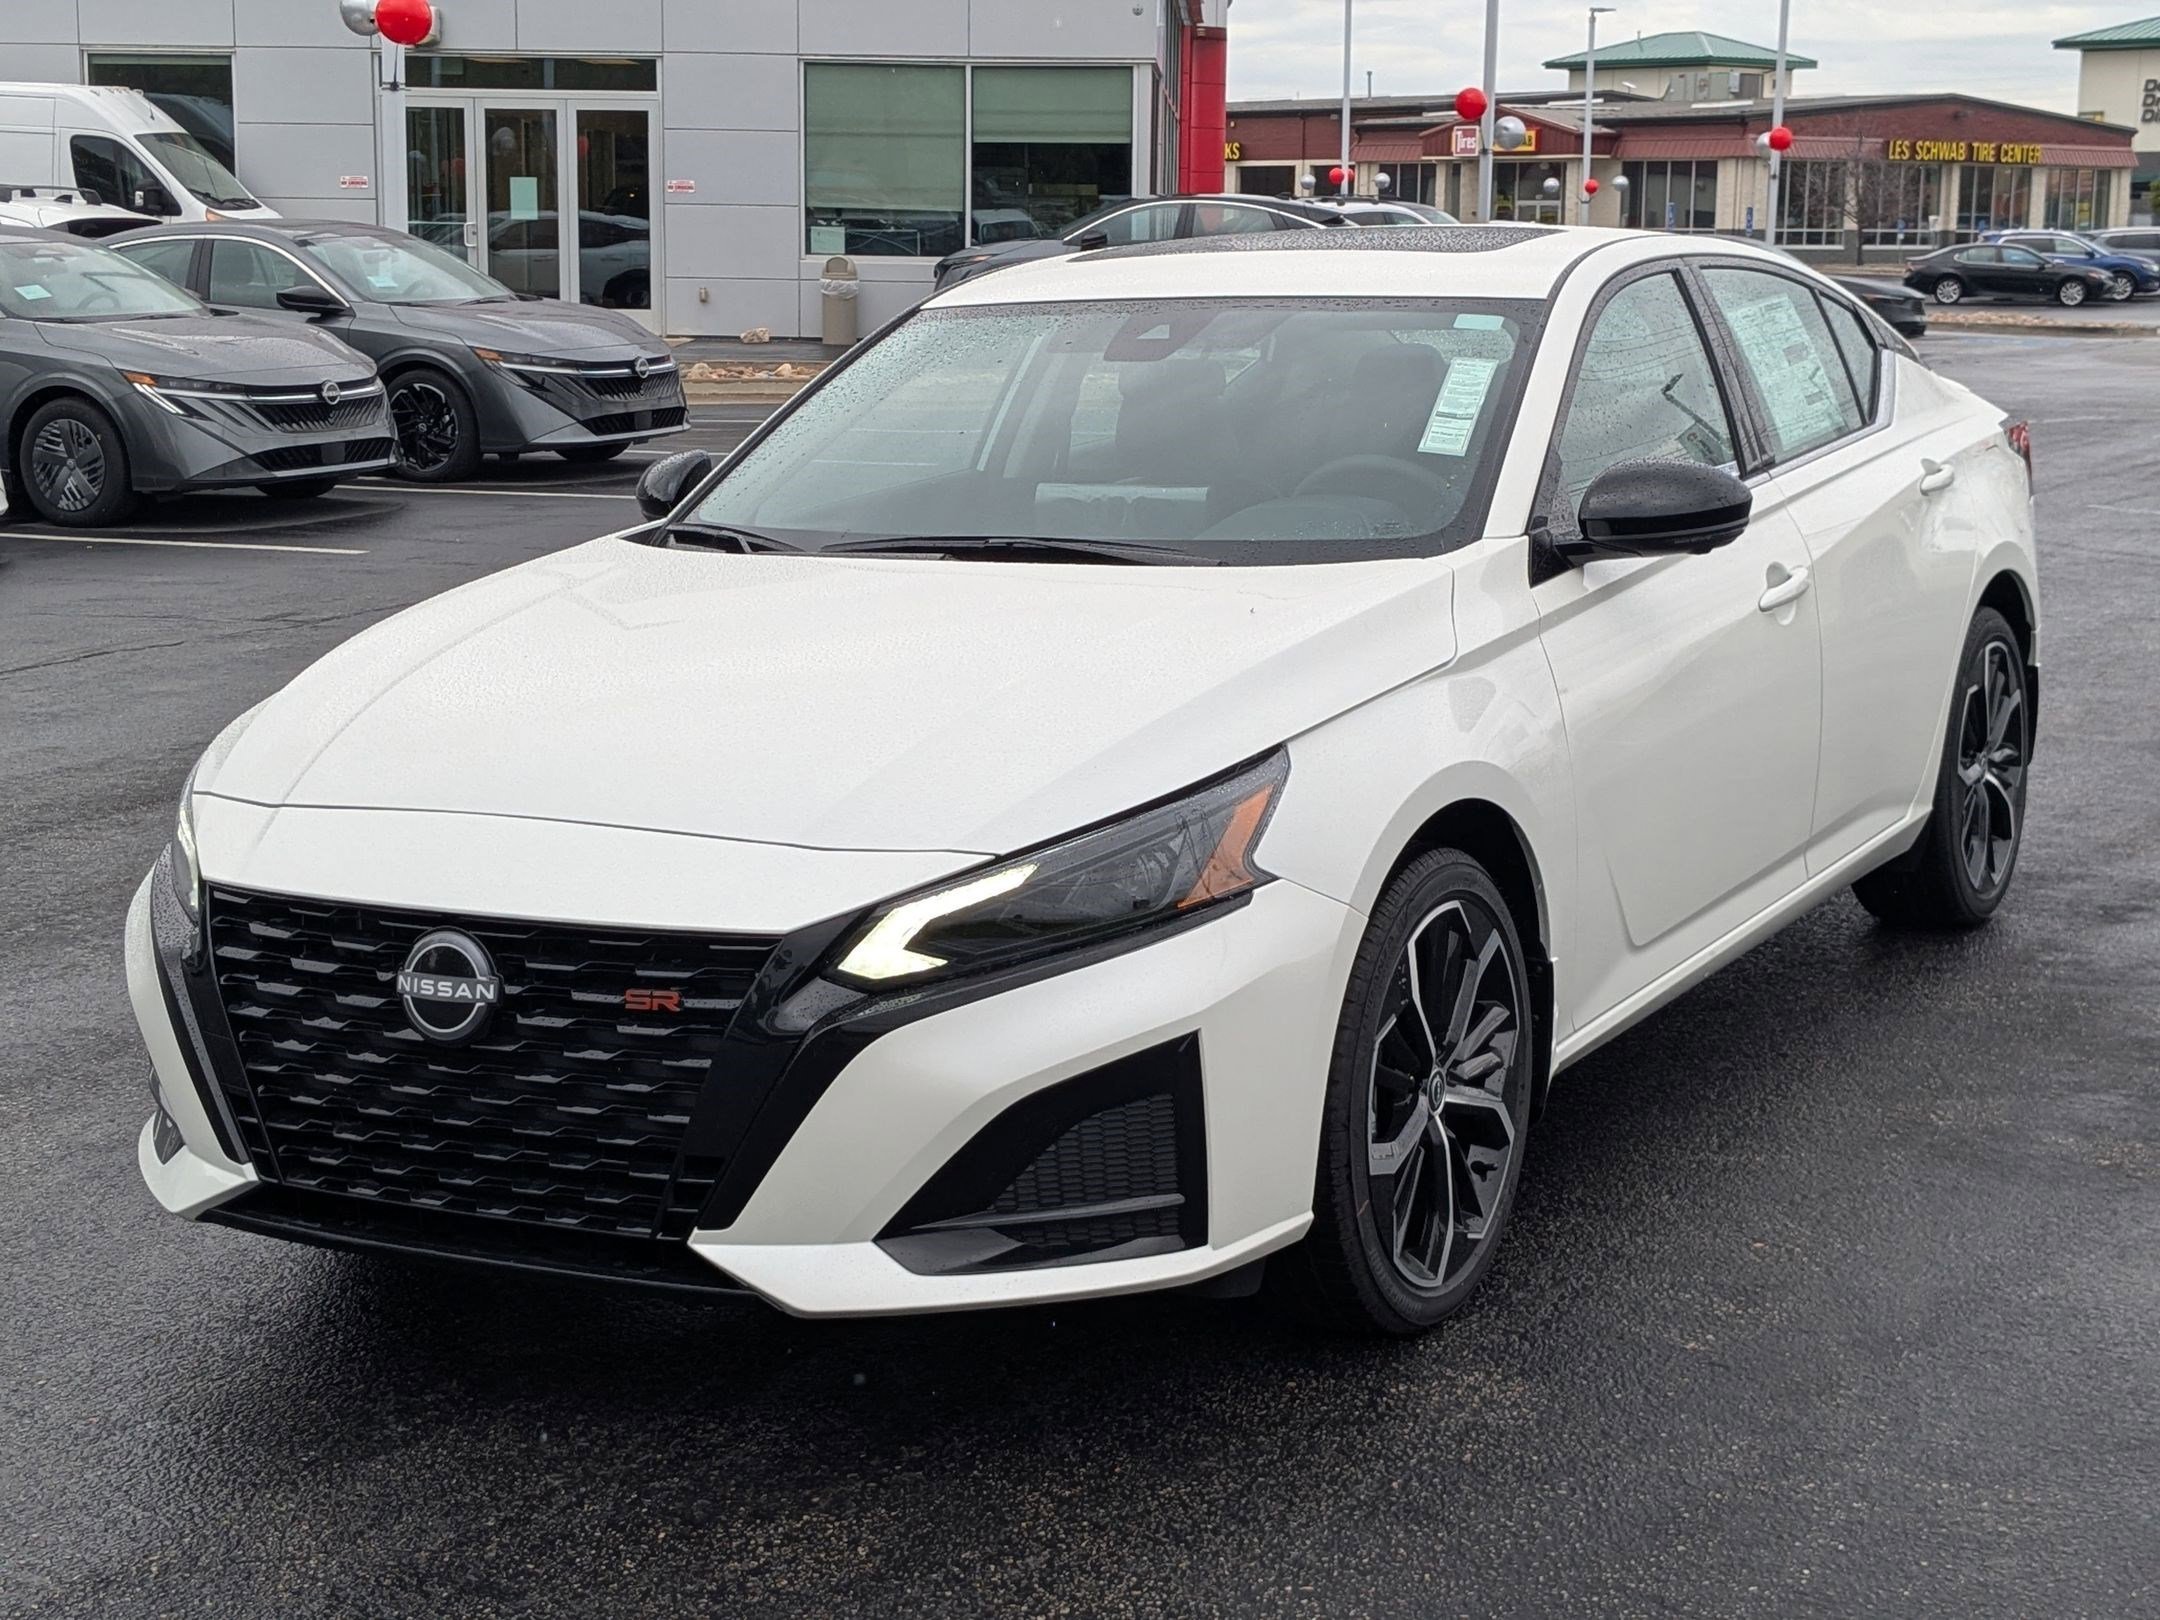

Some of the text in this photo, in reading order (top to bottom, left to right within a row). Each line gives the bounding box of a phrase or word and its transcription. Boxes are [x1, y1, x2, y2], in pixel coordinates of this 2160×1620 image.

[1456, 130, 1477, 153] Tires
[1888, 139, 2042, 163] LES SCHWAB TIRE CENTER
[398, 975, 495, 1000] NISSAN
[625, 989, 681, 1012] SR
